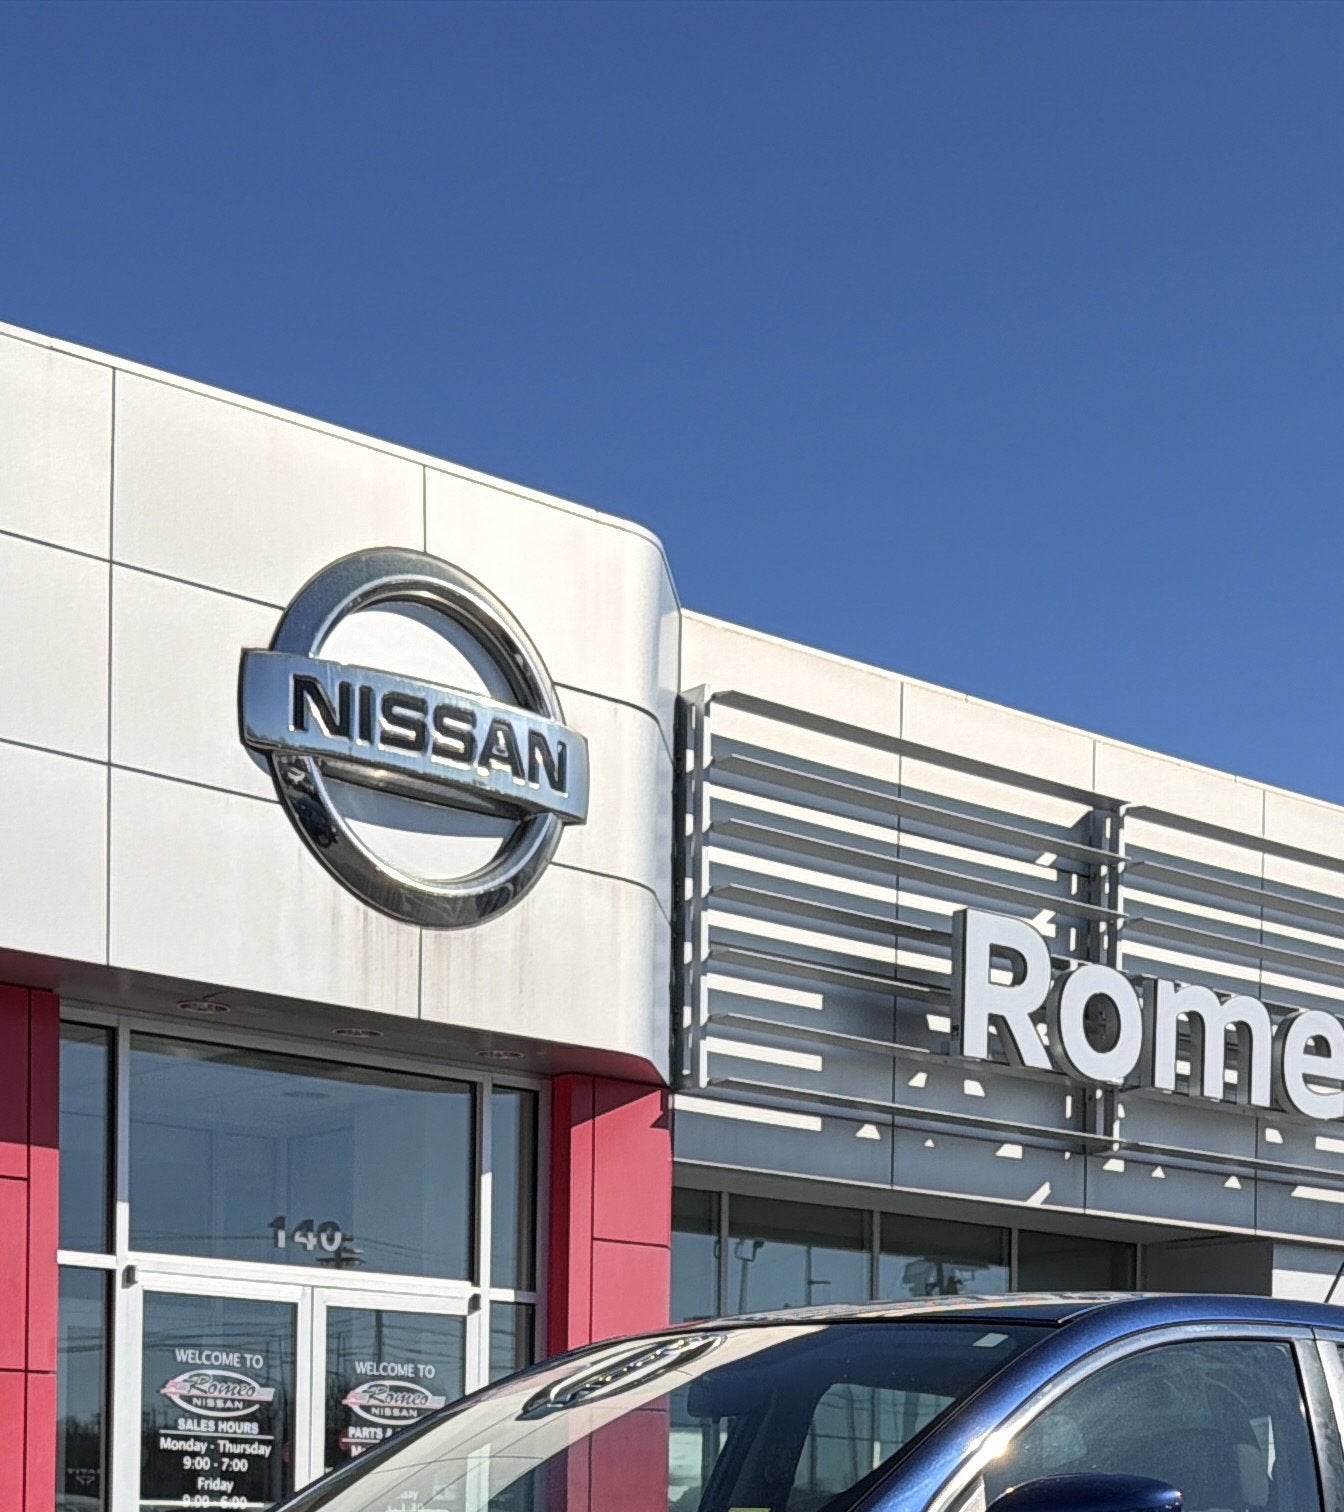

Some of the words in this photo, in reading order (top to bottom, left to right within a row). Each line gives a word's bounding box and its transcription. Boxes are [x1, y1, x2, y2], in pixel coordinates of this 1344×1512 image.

[289, 672, 570, 799] NISSAN
[268, 1216, 342, 1252] 140
[175, 1348, 241, 1367] WELCOME
[244, 1354, 264, 1369] TO
[355, 1361, 415, 1377] WELCOME
[418, 1364, 436, 1379] TO
[183, 1372, 257, 1397] Romeo
[362, 1384, 429, 1405] Romeo
[192, 1398, 244, 1410] NISSAN
[371, 1407, 418, 1418] NISSAN
[178, 1418, 215, 1432] SALES
[218, 1420, 259, 1435] HOURS
[348, 1426, 384, 1440] PARTS
[159, 1436, 207, 1455] Monday
[217, 1440, 272, 1458] Thursday
[182, 1456, 211, 1470] 9:00
[221, 1458, 249, 1472] 7:00
[197, 1477, 234, 1494] Friday
